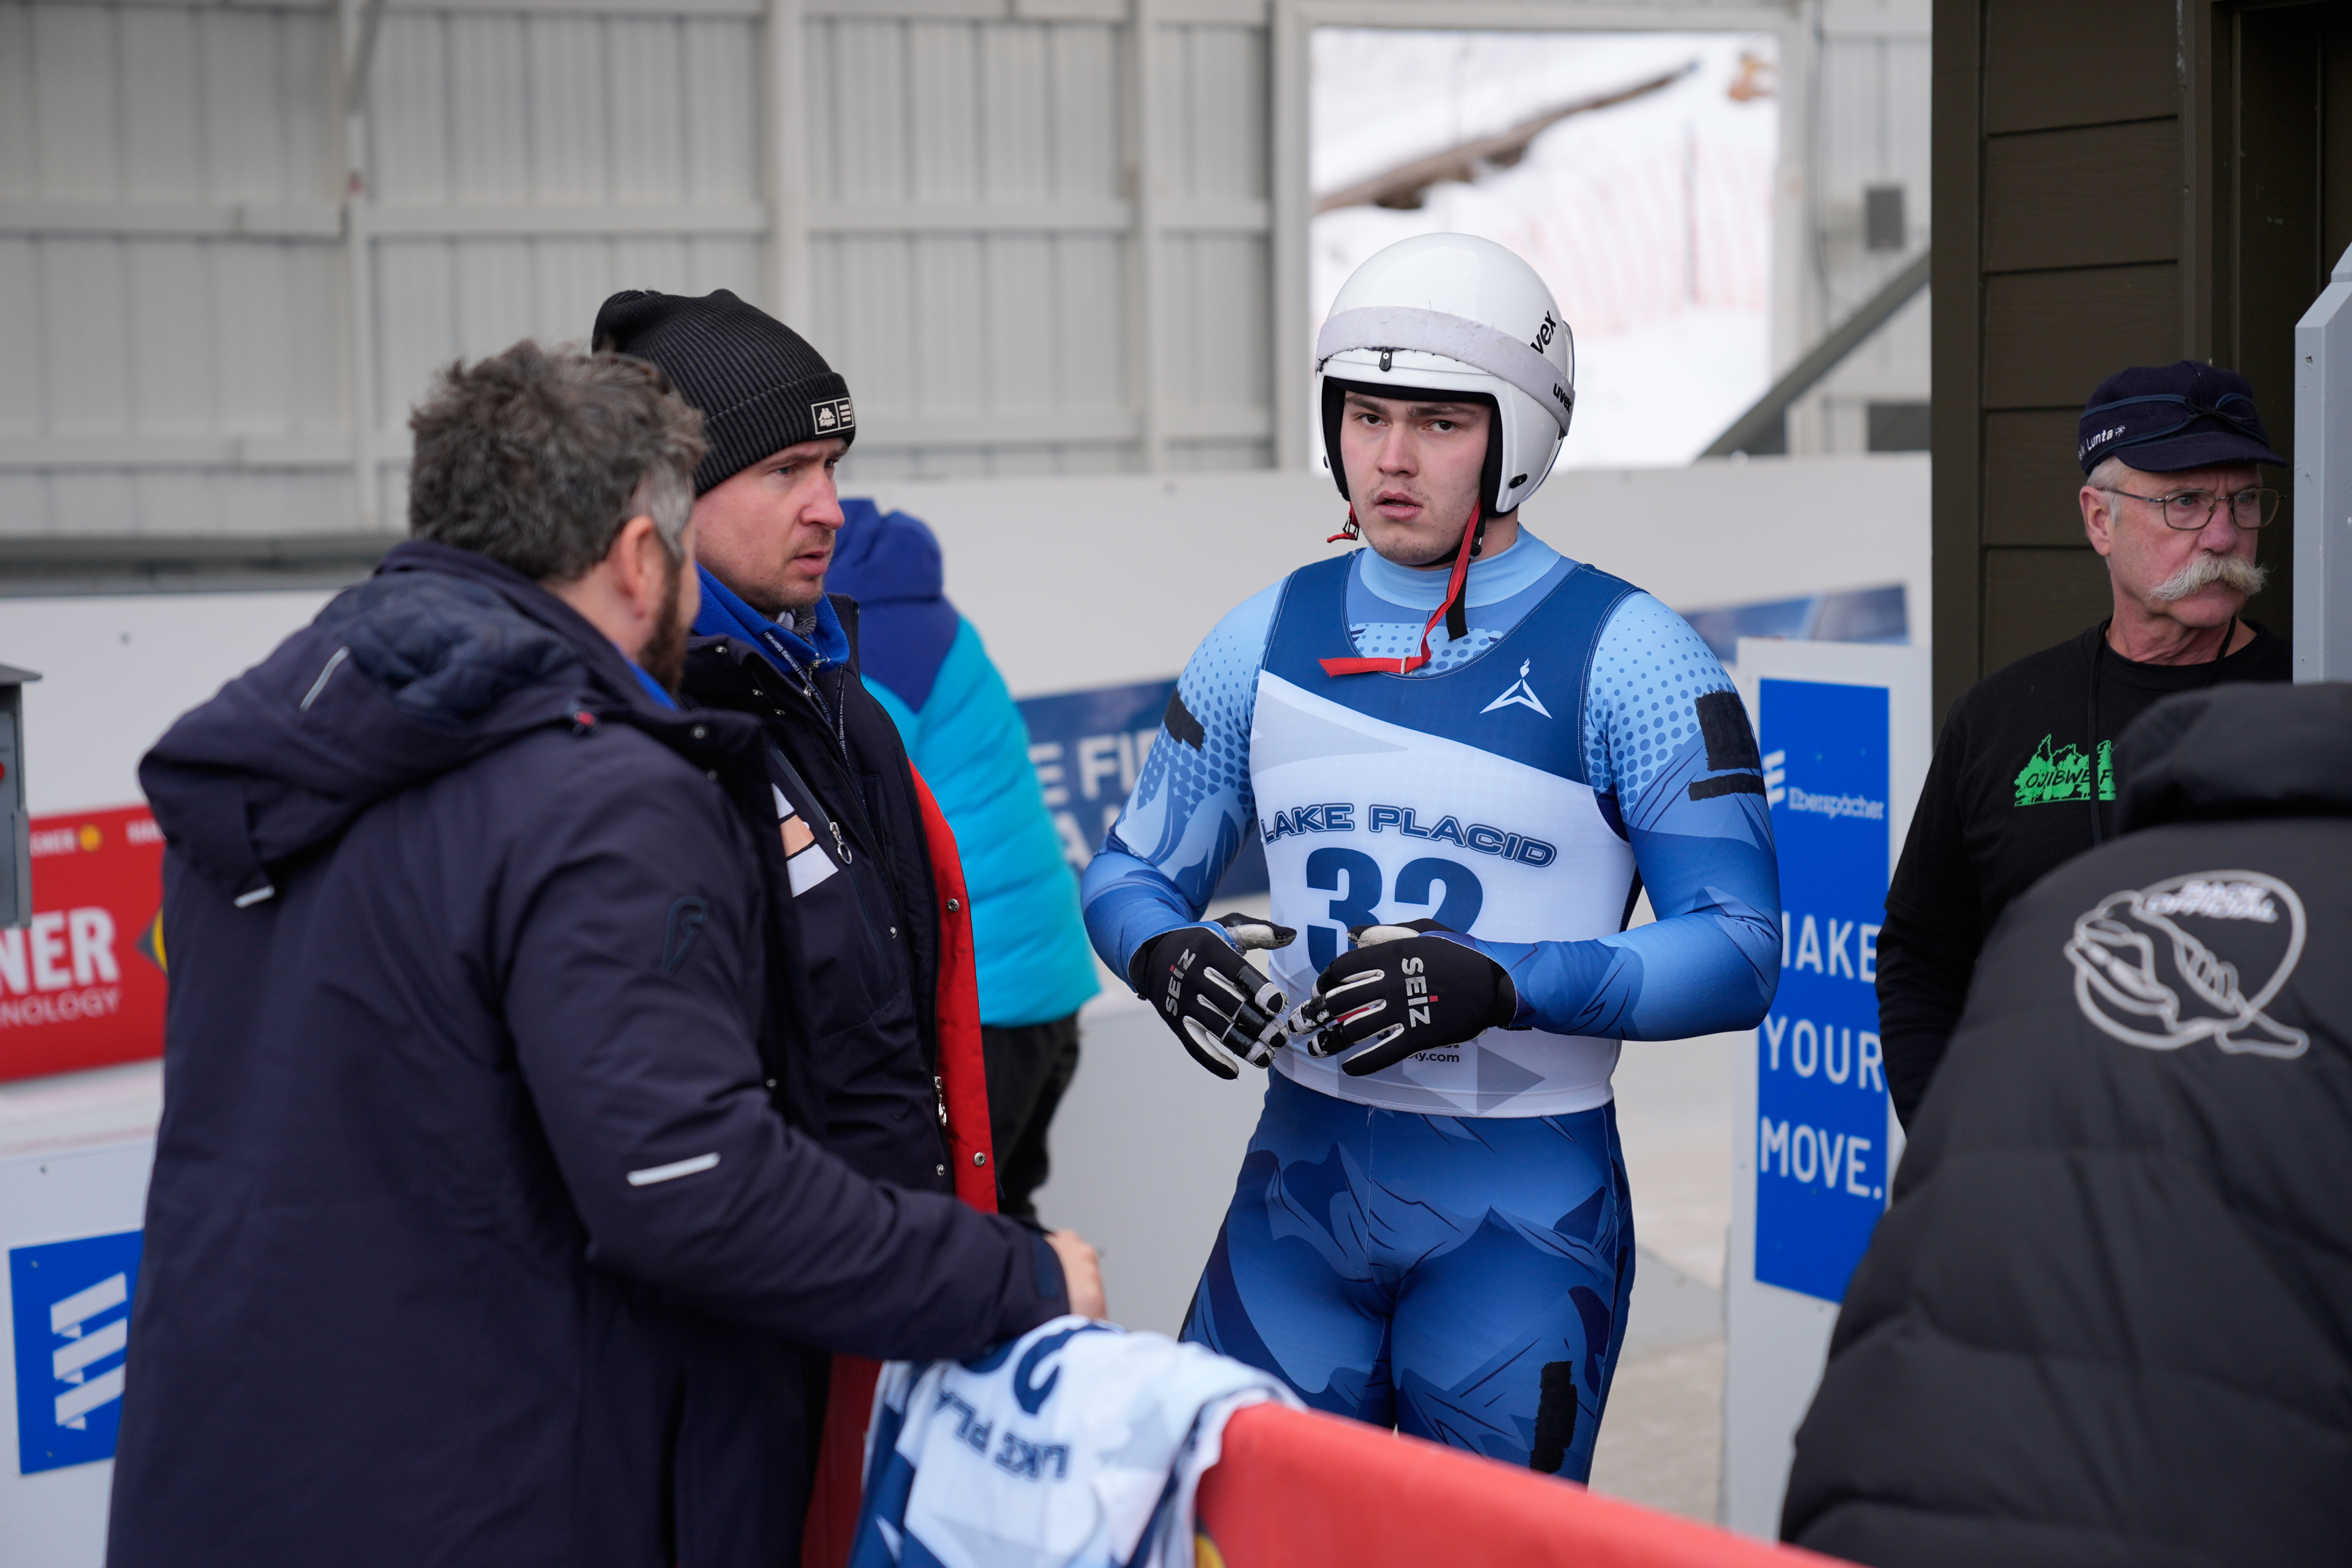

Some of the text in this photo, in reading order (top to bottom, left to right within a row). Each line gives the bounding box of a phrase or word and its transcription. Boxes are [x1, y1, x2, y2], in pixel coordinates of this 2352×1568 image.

[1553, 383, 1572, 414] uvex
[2086, 429, 2113, 451] Lunta
[764, 632, 783, 652] FORWARD
[1260, 802, 1557, 867] LAKE PLACID
[1306, 847, 1483, 975] 32
[1782, 910, 1882, 983] AKE
[1408, 1052, 1459, 1062] y.com
[1764, 1013, 1884, 1092] YOUR
[1760, 1116, 1882, 1200] MOVE.
